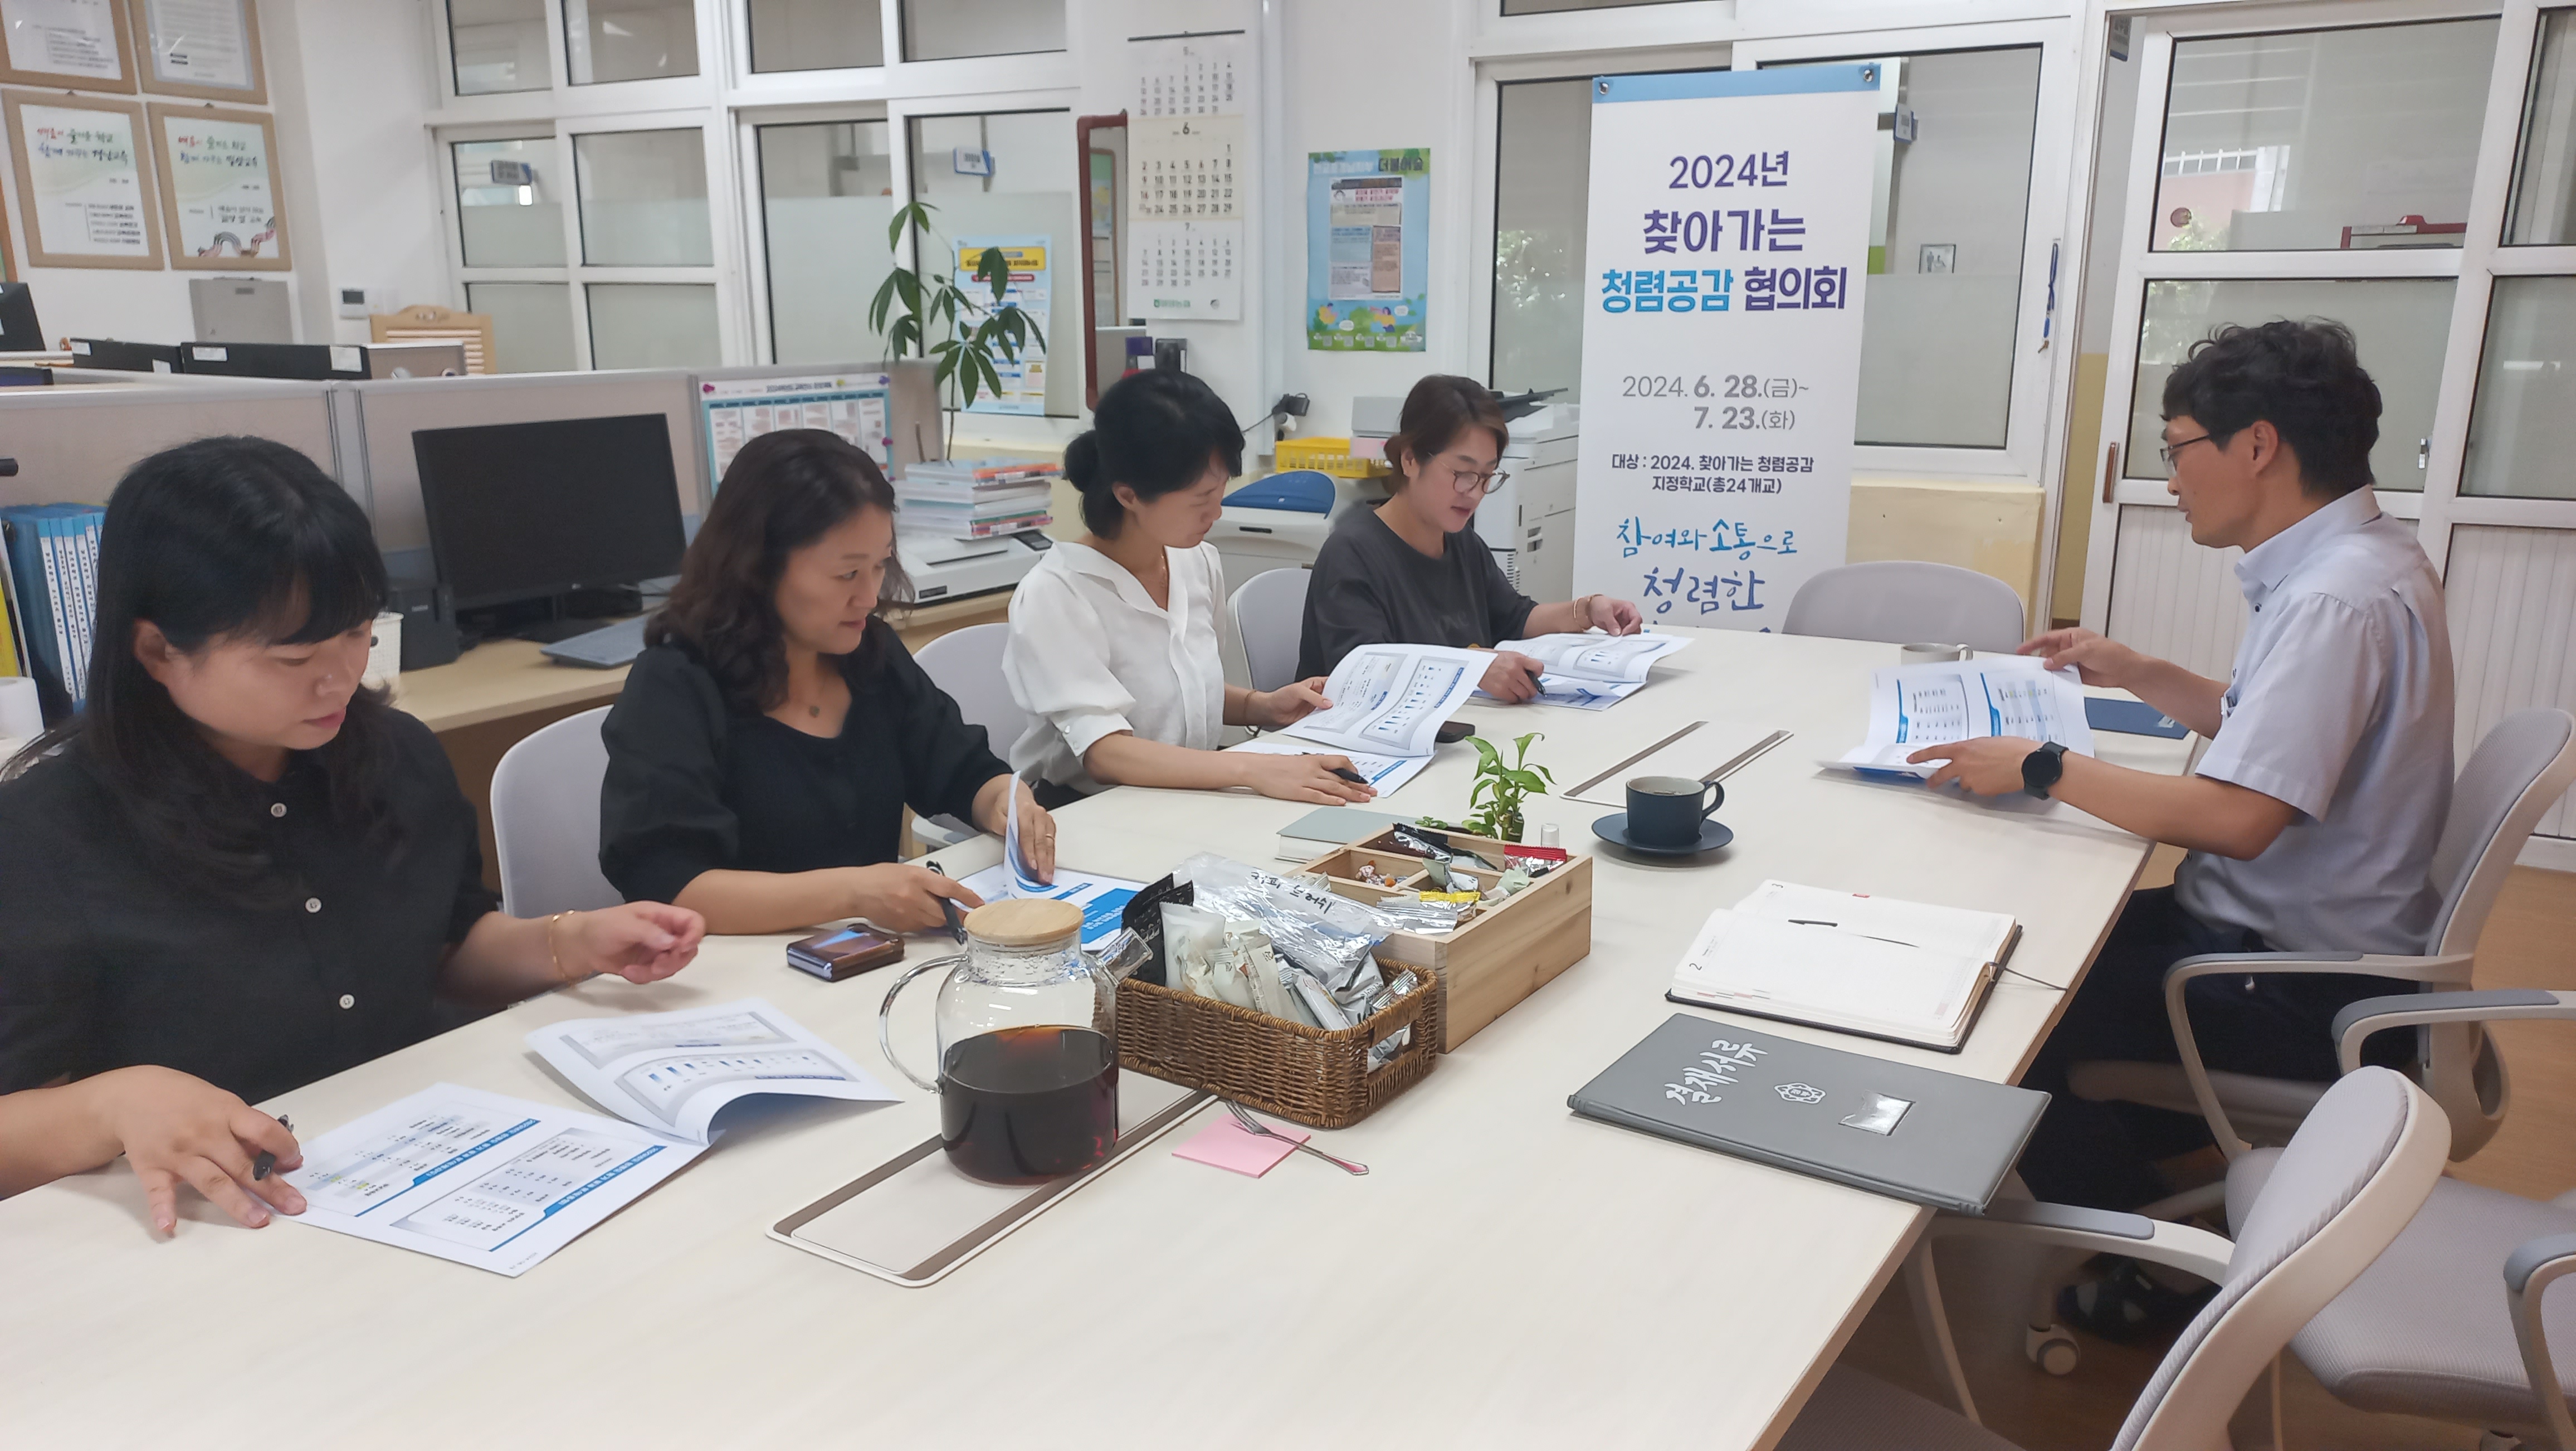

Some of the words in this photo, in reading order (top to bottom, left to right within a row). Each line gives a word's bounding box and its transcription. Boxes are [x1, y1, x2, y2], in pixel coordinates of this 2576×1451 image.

[1183, 121, 1190, 135] 6
[1669, 150, 1789, 189] 2024년
[1643, 209, 1806, 255] 찾아가는
[1602, 269, 1734, 313] 청렴공감
[1744, 265, 1847, 311] 협의회
[1622, 376, 1688, 397] 2024.
[1694, 375, 1715, 398] 6.
[1724, 374, 1809, 398] 28.(금)~
[1694, 406, 1713, 429] 7.
[1722, 406, 1796, 430] 23.(화)
[1612, 454, 1639, 470] 대상
[1651, 455, 1694, 470] 2024.
[1699, 455, 1754, 471] 찾아가는
[1758, 456, 1814, 473] 청렴공감
[1652, 475, 1782, 494] 지정학교(총24개교)
[1616, 516, 1707, 558] 참여와
[1709, 518, 1797, 561] 소통으로
[1643, 566, 1765, 615] 청렴한
[1663, 1038, 1768, 1106] 결재서류
